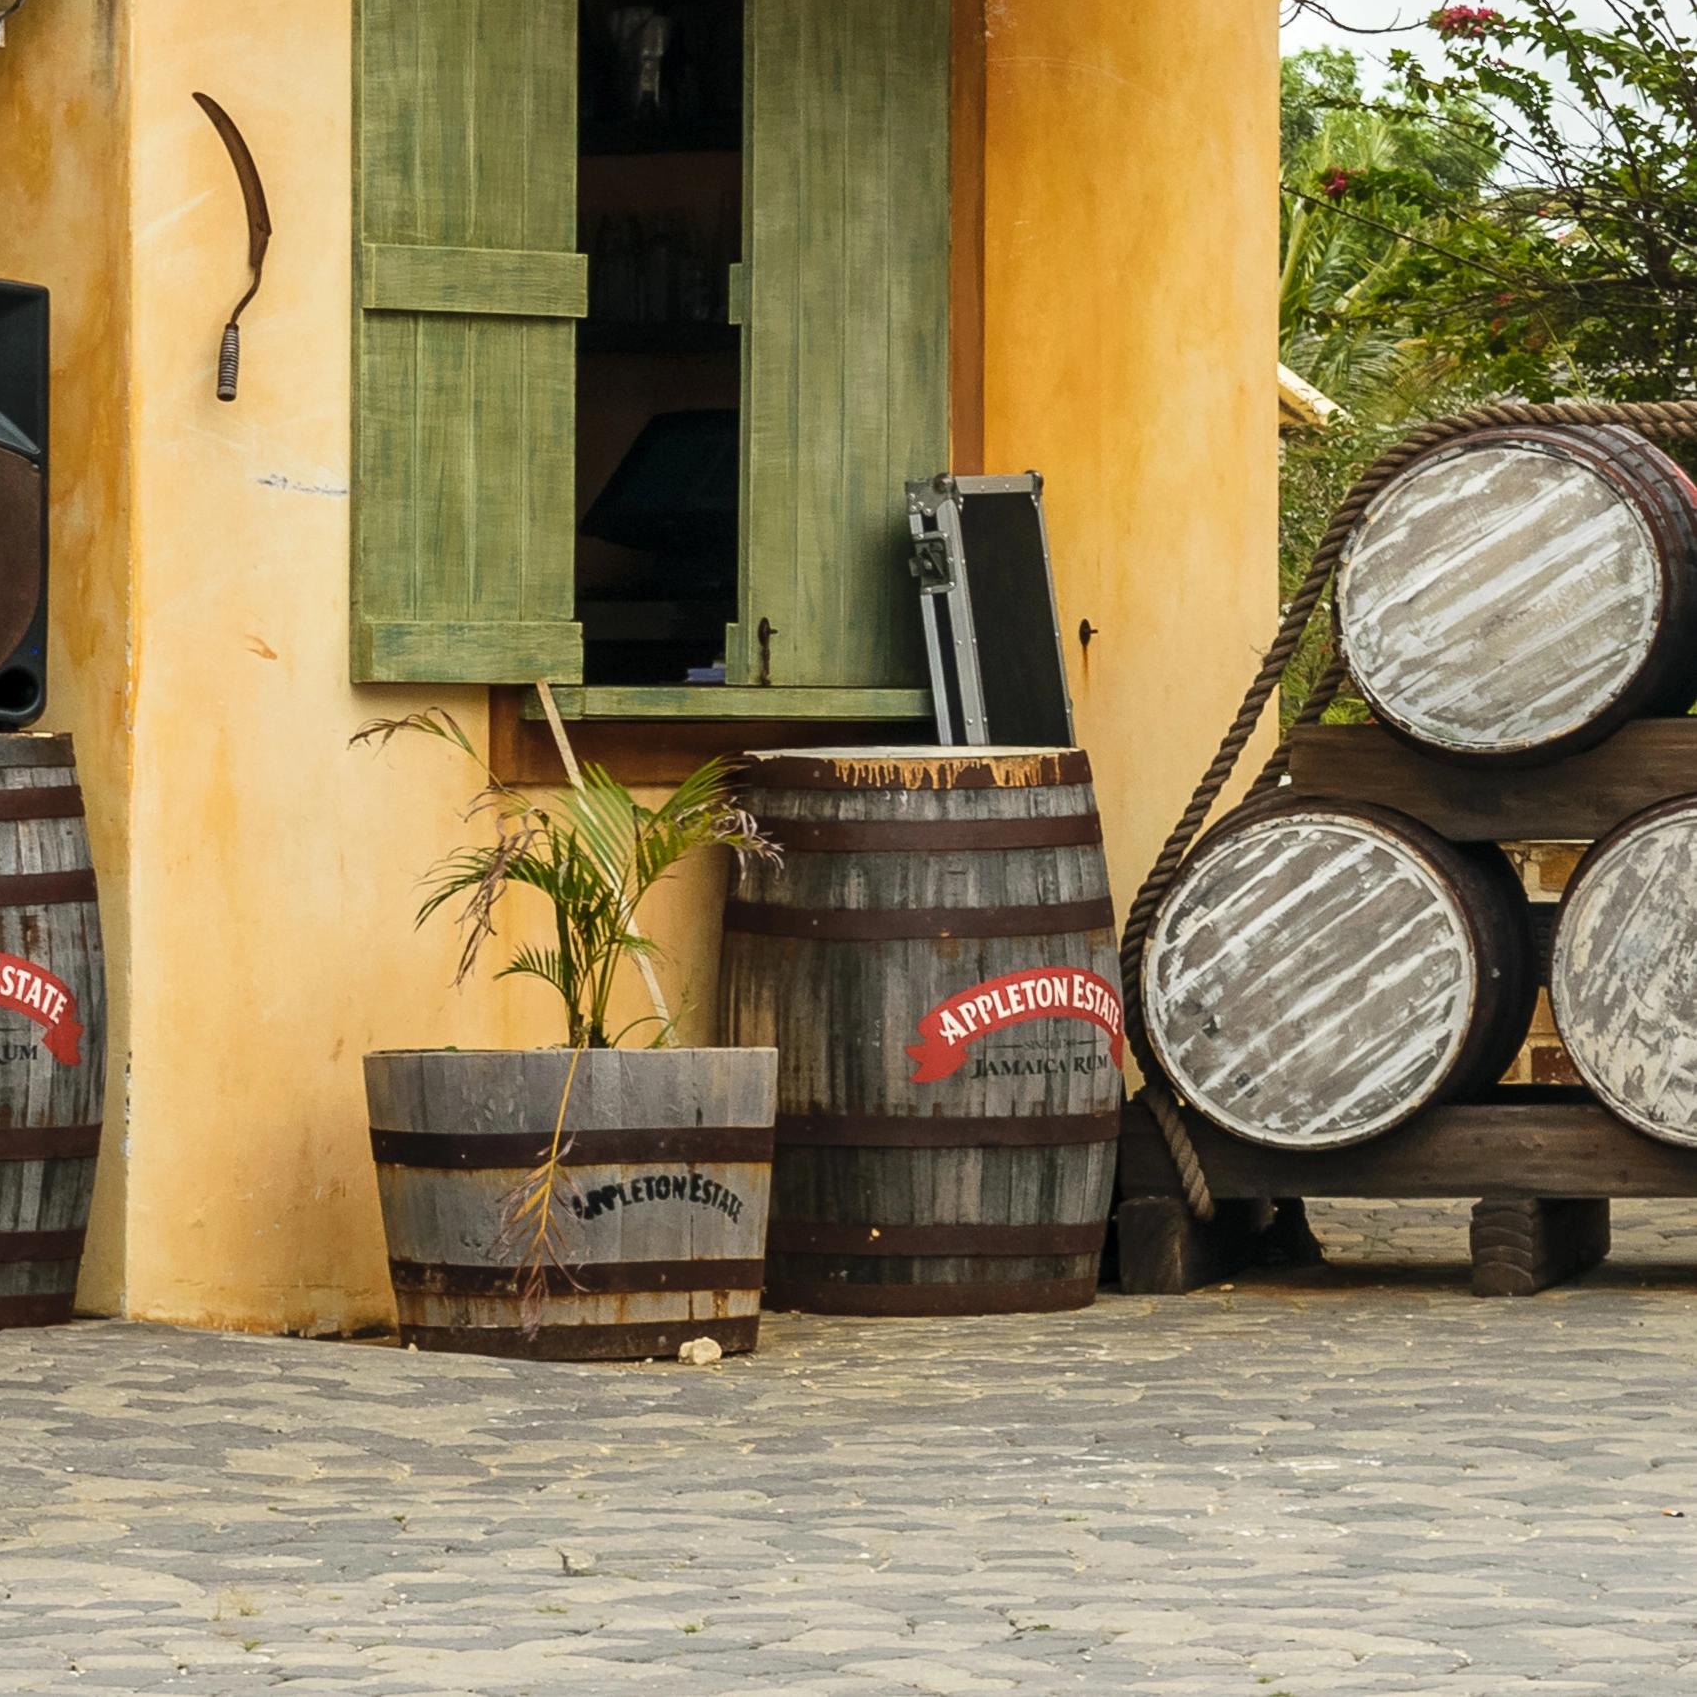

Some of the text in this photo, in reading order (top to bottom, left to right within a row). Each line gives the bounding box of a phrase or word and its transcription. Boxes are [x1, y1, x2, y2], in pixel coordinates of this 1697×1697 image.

[939, 974, 1120, 1046] APPLETON ESTATE
[970, 1054, 1108, 1079] JAMAICA RUM
